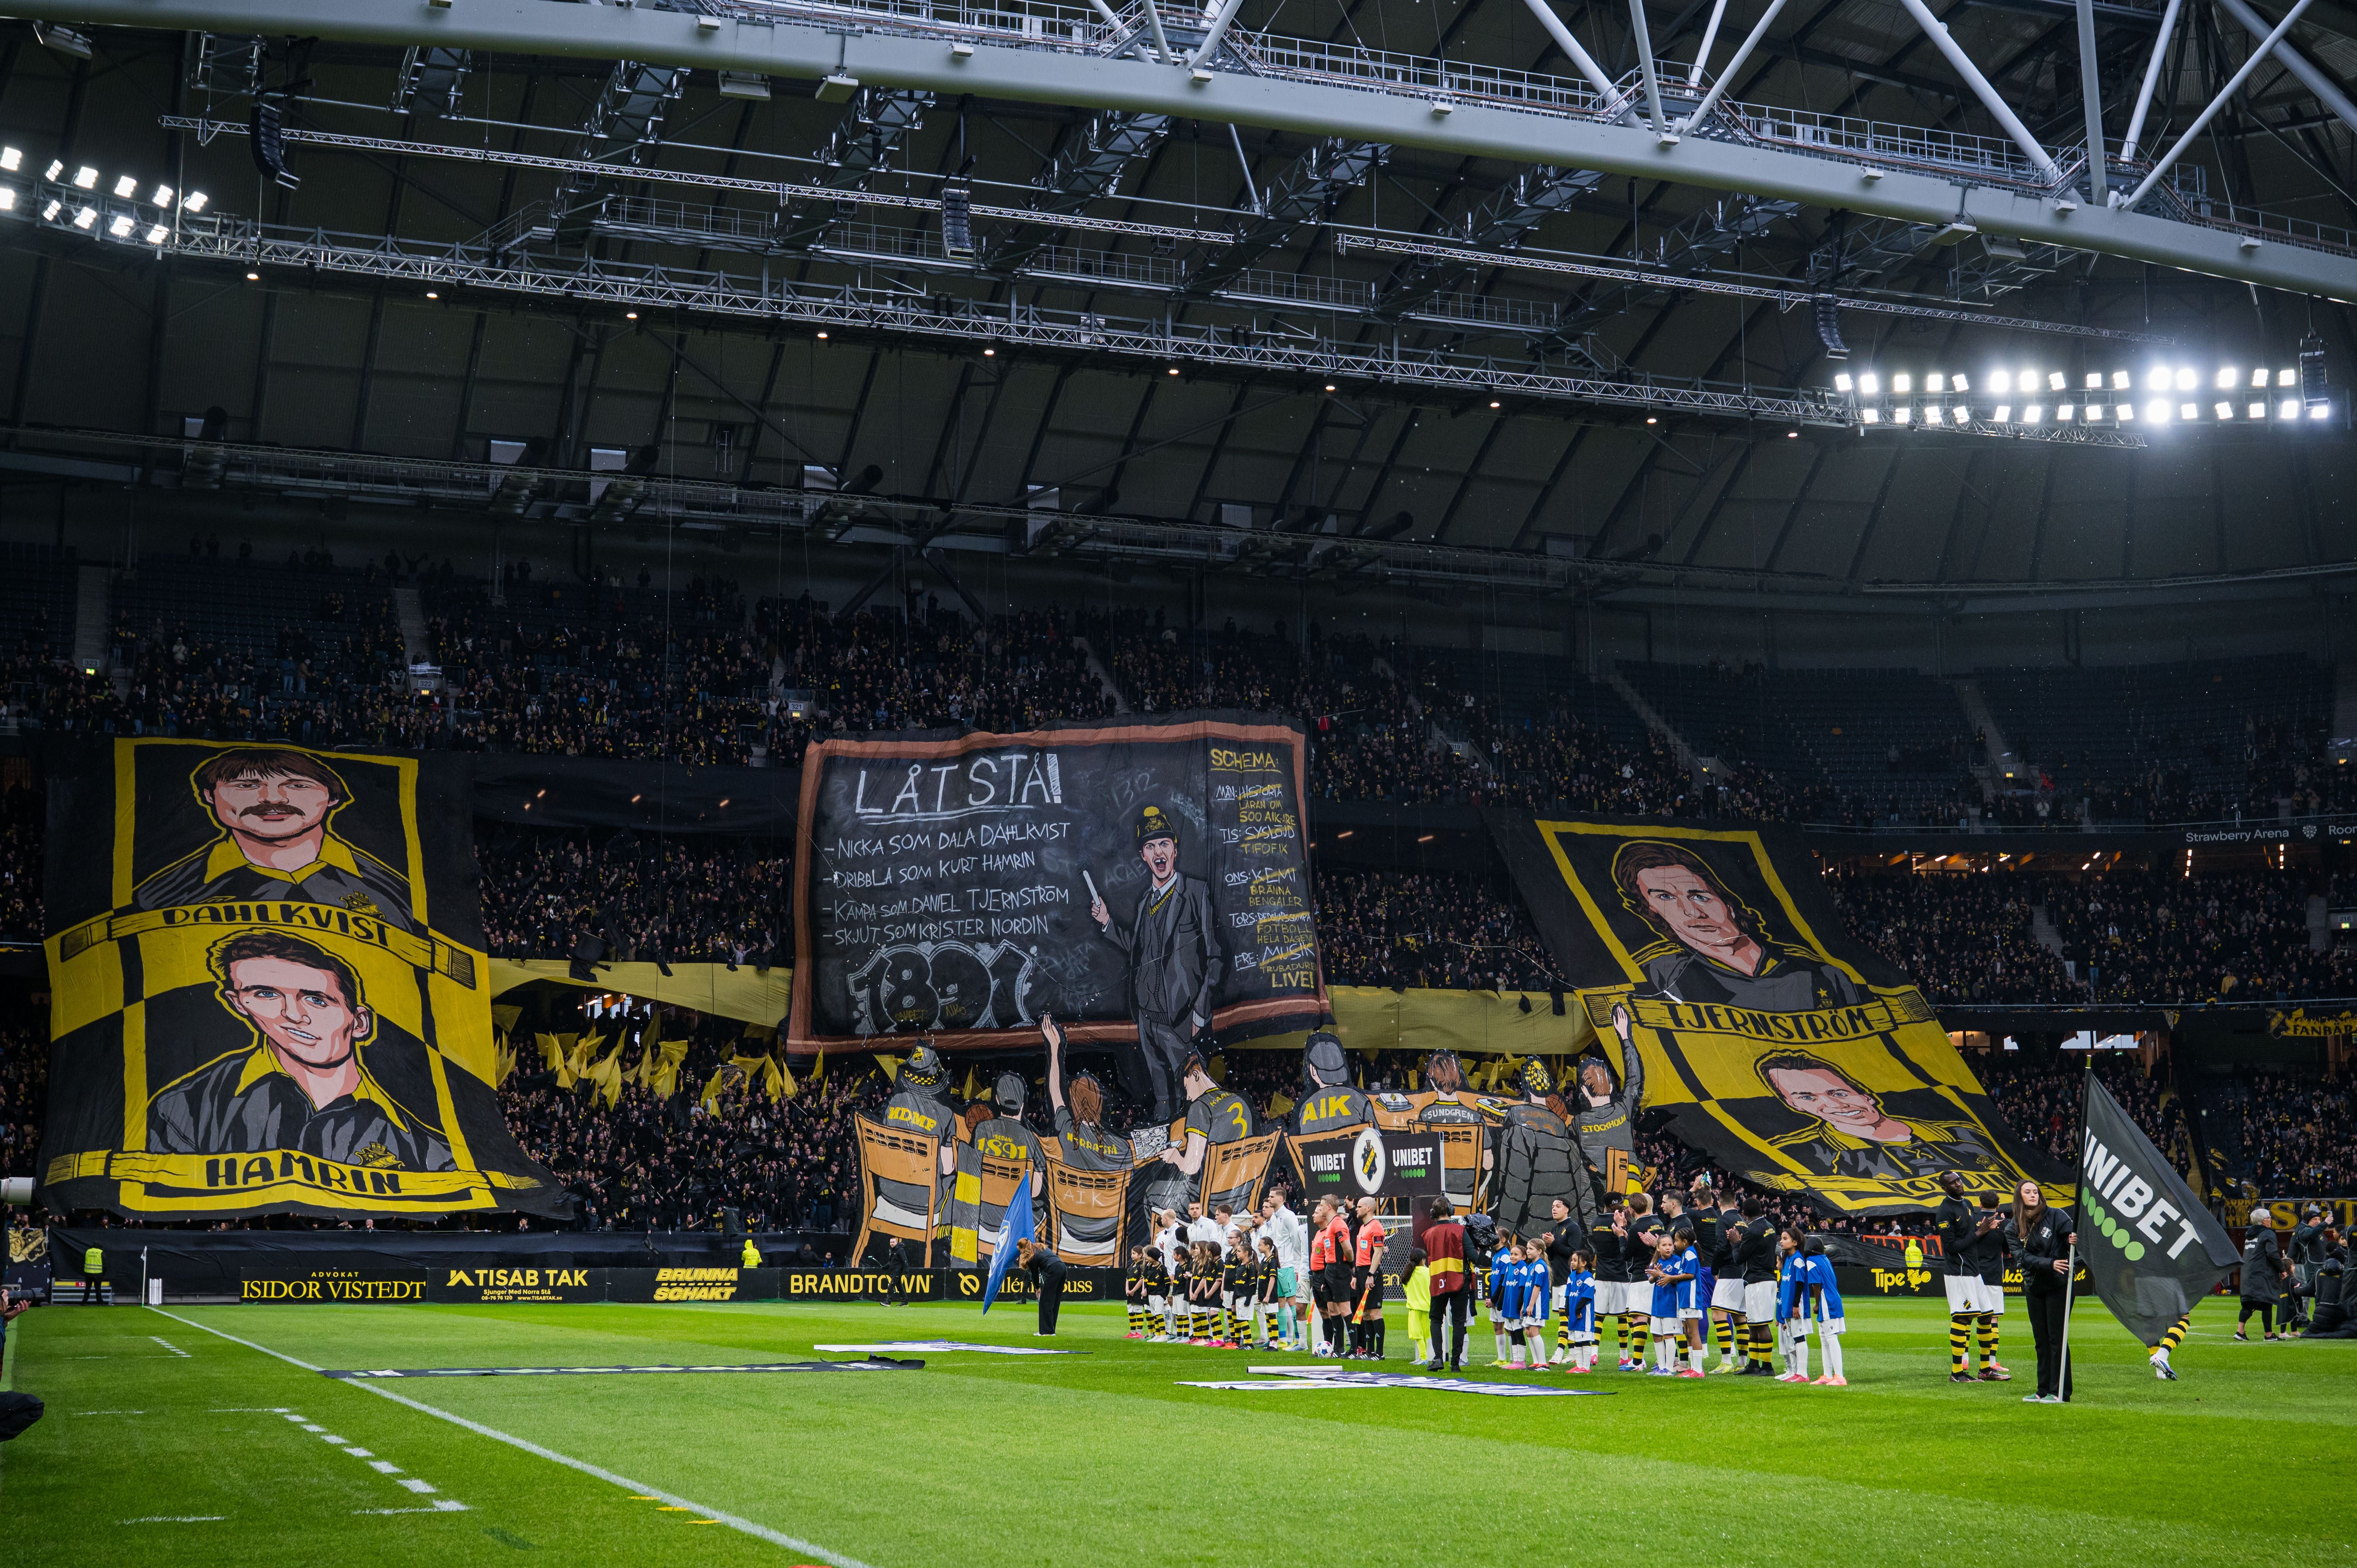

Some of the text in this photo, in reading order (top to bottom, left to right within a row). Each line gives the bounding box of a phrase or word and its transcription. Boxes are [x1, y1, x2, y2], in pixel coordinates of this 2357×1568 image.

[1211, 748, 1279, 769] SCHEMA:
[855, 752, 1062, 813] LÅT STÅ!
[1239, 800, 1283, 810] LÄRAN OM
[838, 837, 884, 860] NICKA
[889, 833, 930, 855] SOM
[938, 828, 975, 850] DALA
[980, 823, 1071, 847] DAHLKVIST
[2186, 828, 2289, 843] Strawberry Arena
[1239, 843, 1288, 855] TIFOFIX
[836, 868, 892, 889] DRIBBLA
[900, 865, 931, 884] SOM
[939, 856, 978, 878] KURT
[982, 850, 1035, 872] HAMRIN
[1252, 867, 1296, 884] KEMI
[1250, 884, 1292, 896] BRÄNNA
[835, 899, 876, 923] KÄMPA
[880, 899, 907, 916] SOM
[912, 893, 961, 914] DANIEL
[966, 885, 1069, 912] TJERNSTRÖM
[163, 903, 391, 950] DAHLKVIST
[835, 924, 881, 946] SKJUT
[884, 923, 916, 941] SOM
[919, 920, 985, 941] KRISTER
[991, 915, 1049, 939] NORDIN
[1257, 924, 1313, 934] FOTBOLL
[1258, 935, 1279, 944] HELA
[1262, 942, 1315, 962] MUSIK
[1272, 971, 1314, 988] LIVE!
[1659, 1002, 1874, 1040] TJERNSTRÖM
[1302, 1095, 1351, 1125] AIK
[1427, 1108, 1474, 1121] SUNDGREN
[1227, 1102, 1248, 1139] 3
[1581, 1113, 1627, 1133] STOCKHOLM
[977, 1137, 1027, 1159] 1891
[1392, 1147, 1433, 1167] UNIBET
[1310, 1153, 1346, 1172] UNIBET
[206, 1152, 403, 1195] HAMRIN
[1878, 1171, 2016, 1196] NODIN
[1063, 1188, 1105, 1207] AIK
[475, 1269, 588, 1286] TISAB TAK
[656, 1268, 738, 1281] BRUNNA
[241, 1280, 426, 1299] ISIDOR VISTEDT
[654, 1287, 737, 1301] SCHAKT
